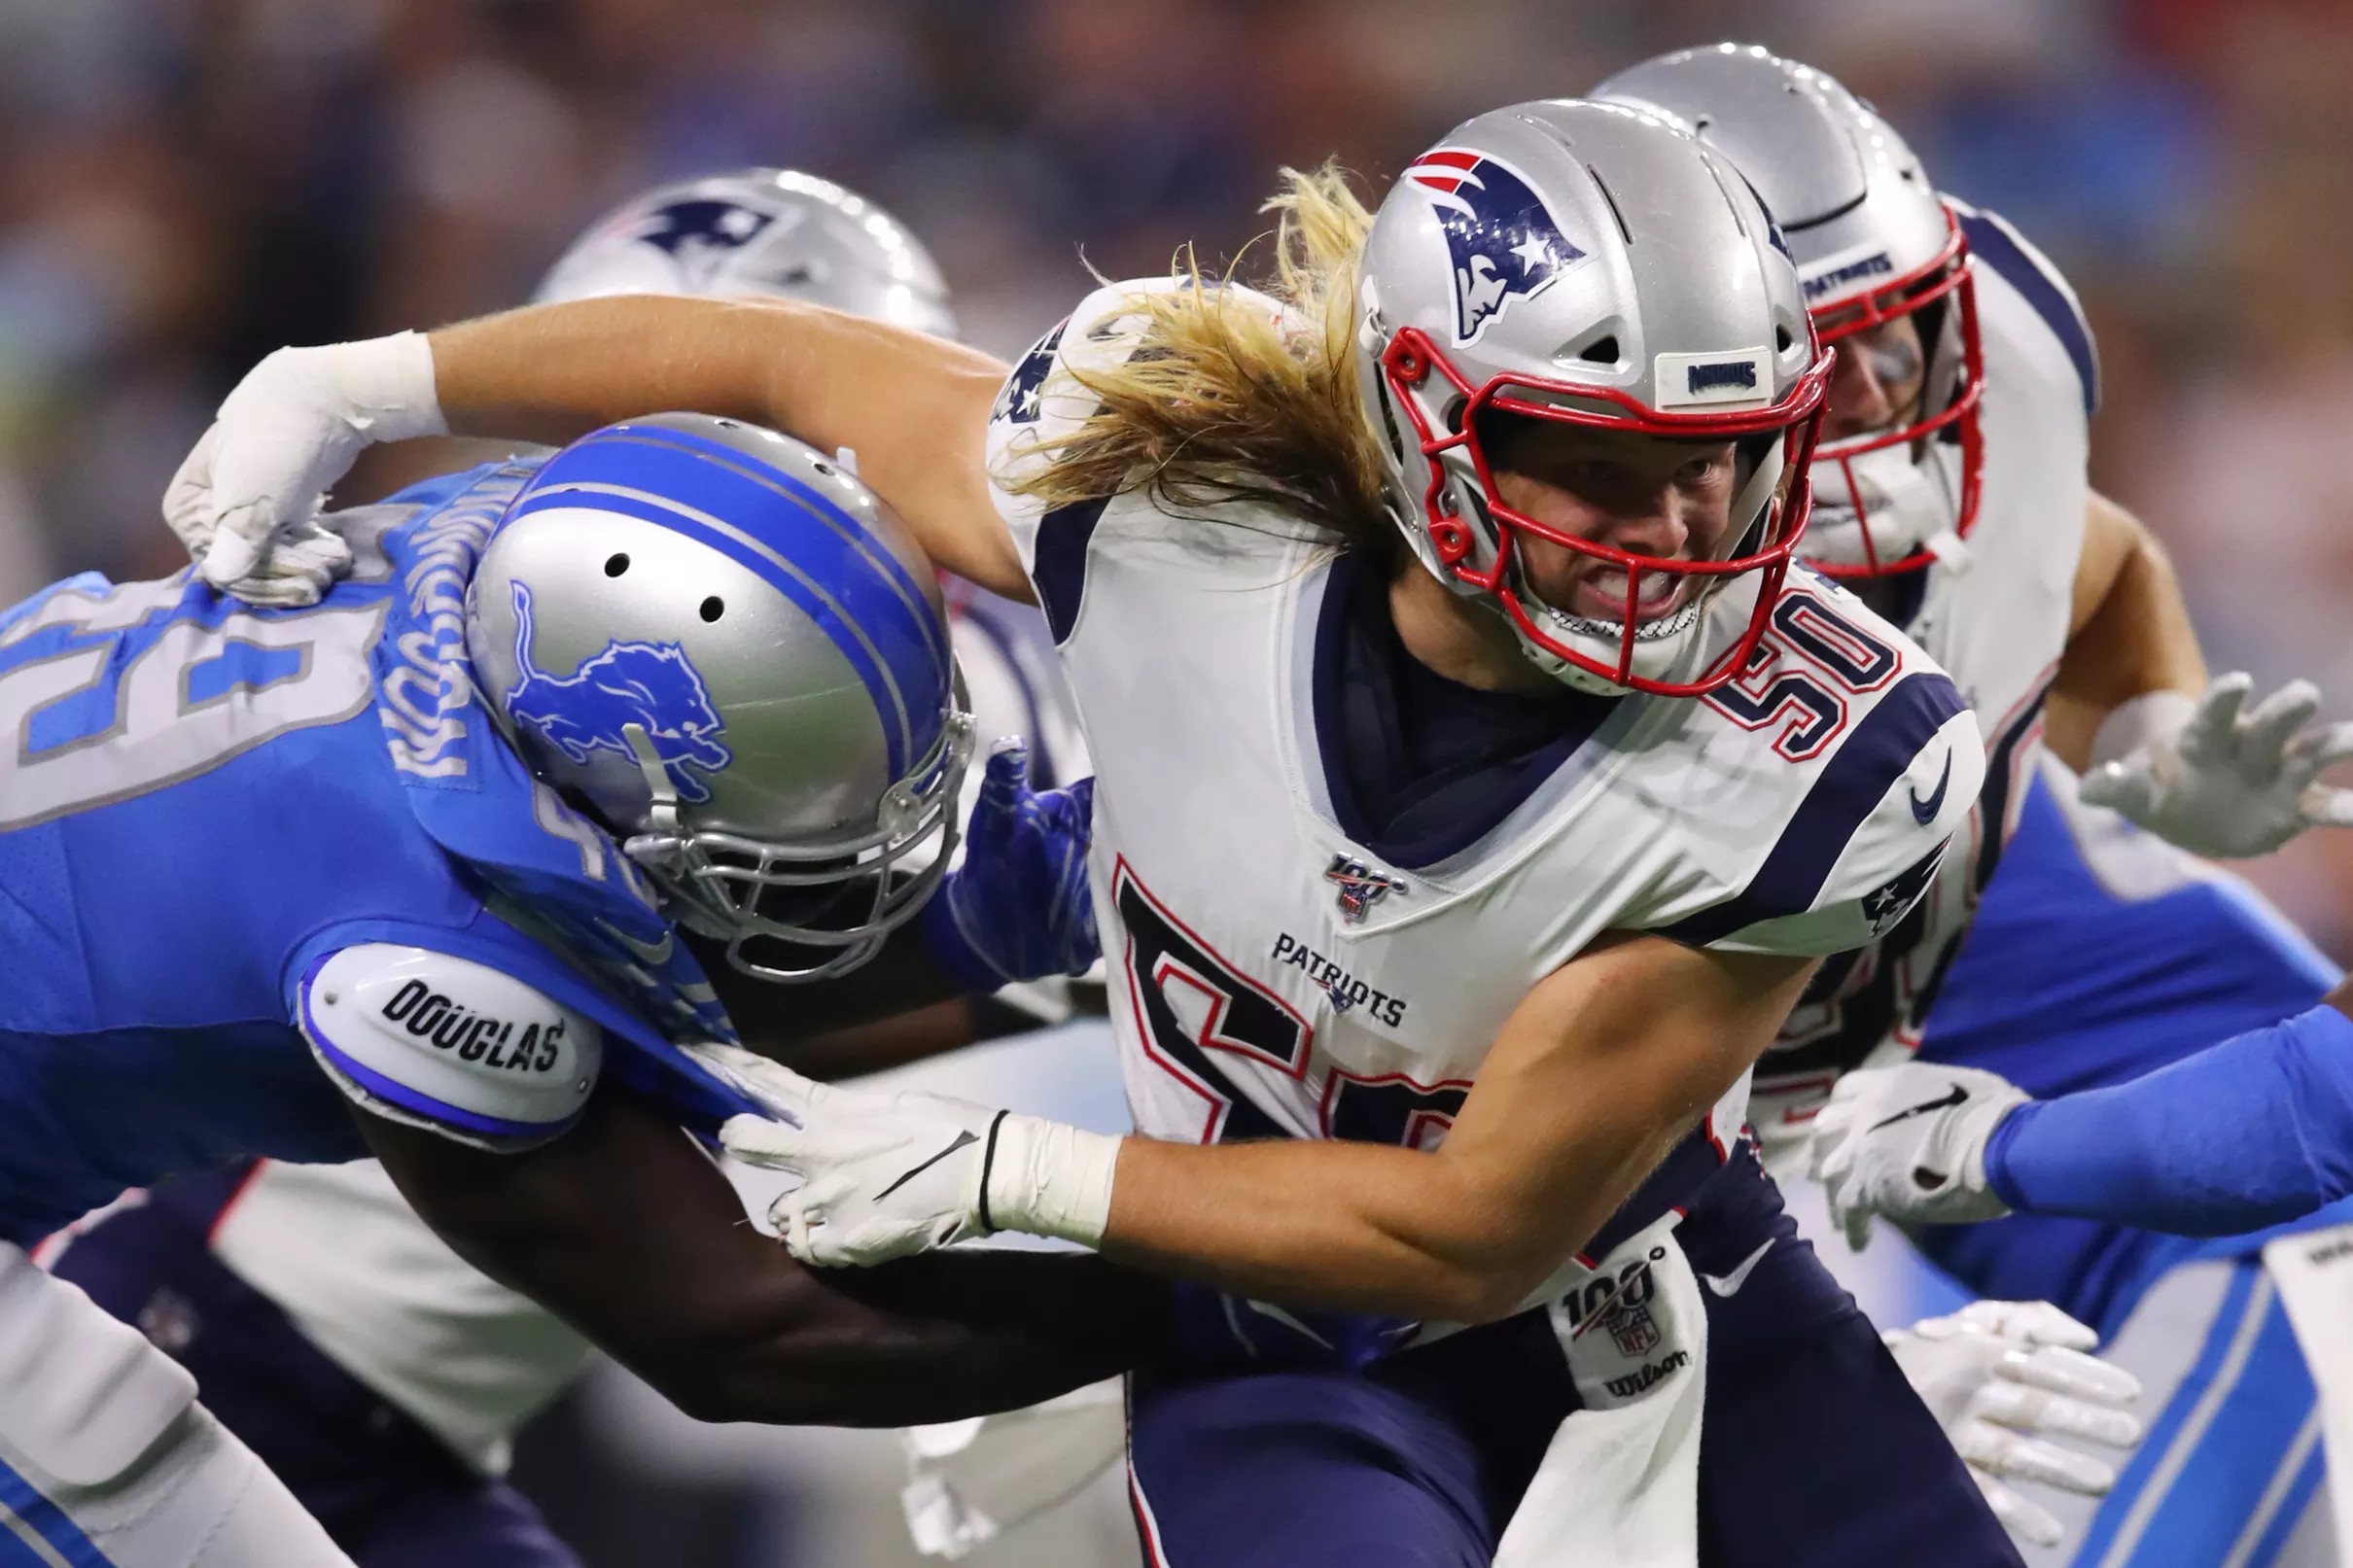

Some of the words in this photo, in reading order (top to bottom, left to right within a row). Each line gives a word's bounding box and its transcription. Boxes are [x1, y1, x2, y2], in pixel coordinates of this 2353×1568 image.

[1697, 587, 1903, 763] 50
[382, 978, 565, 1072] DOUGLAS
[1272, 931, 1407, 1028] PATRIOTS
[1603, 1349, 1689, 1397] Wilson
